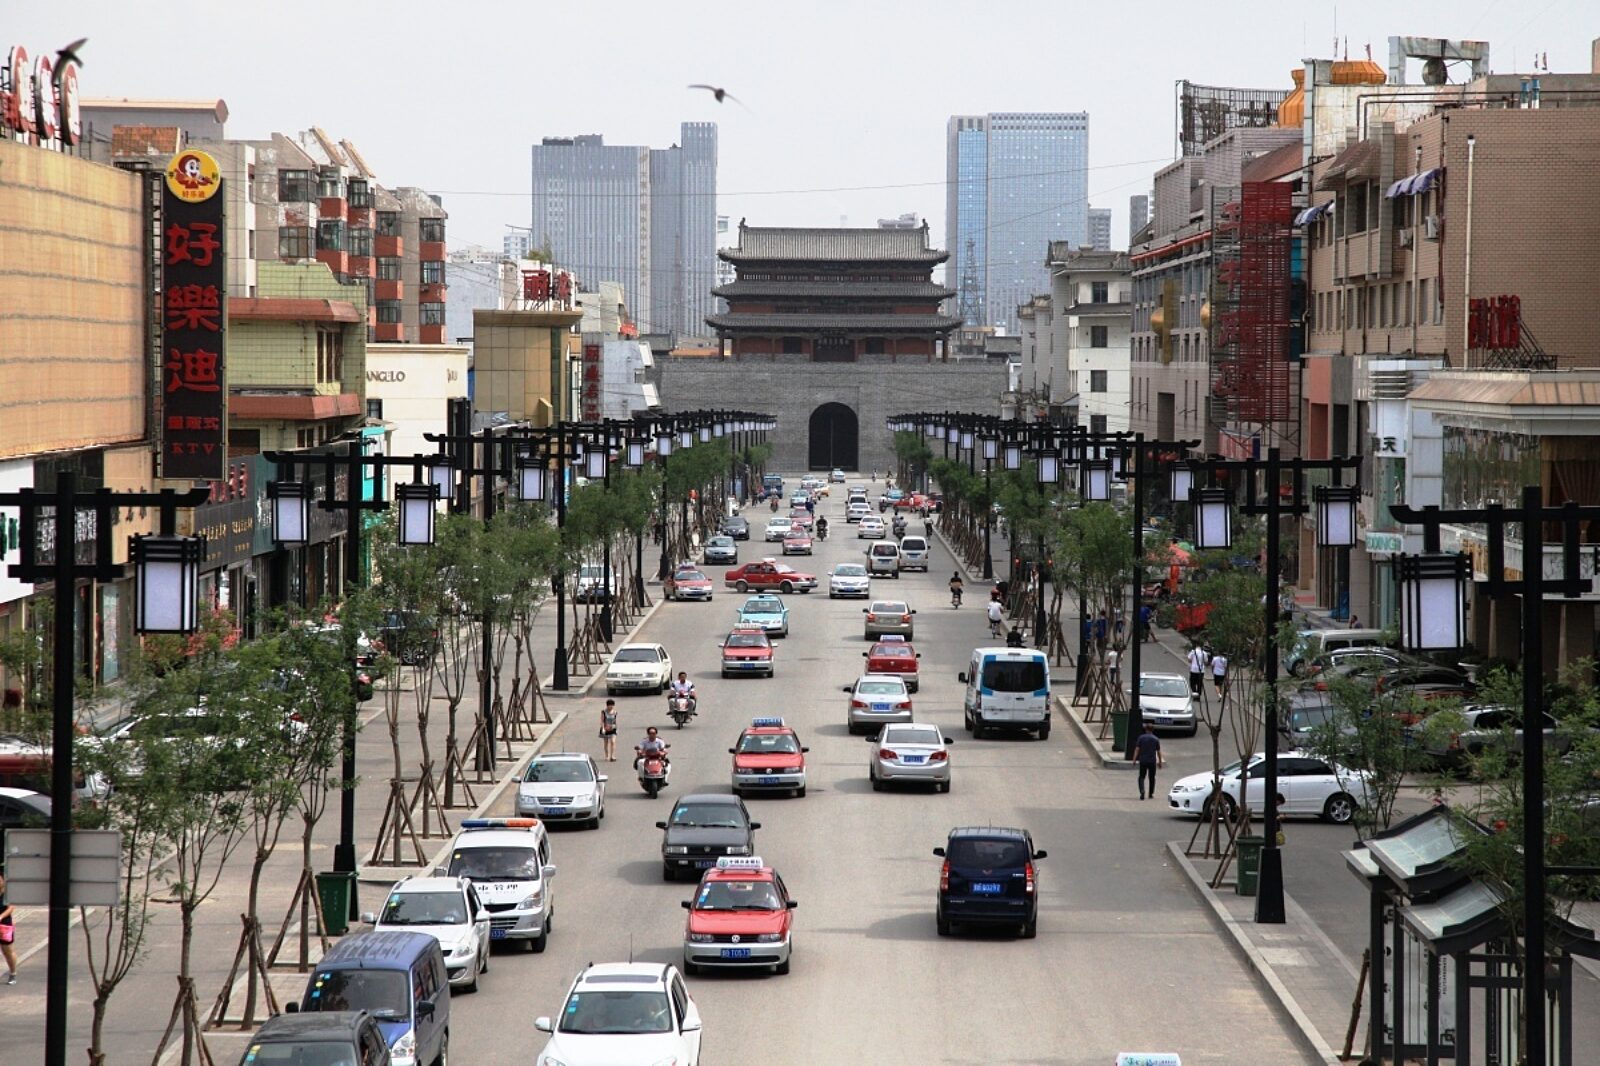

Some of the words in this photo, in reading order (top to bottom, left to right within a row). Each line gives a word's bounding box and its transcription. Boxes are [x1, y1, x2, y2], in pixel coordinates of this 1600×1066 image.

[166, 222, 221, 392] 好樂迪
[171, 441, 216, 455] KTV
